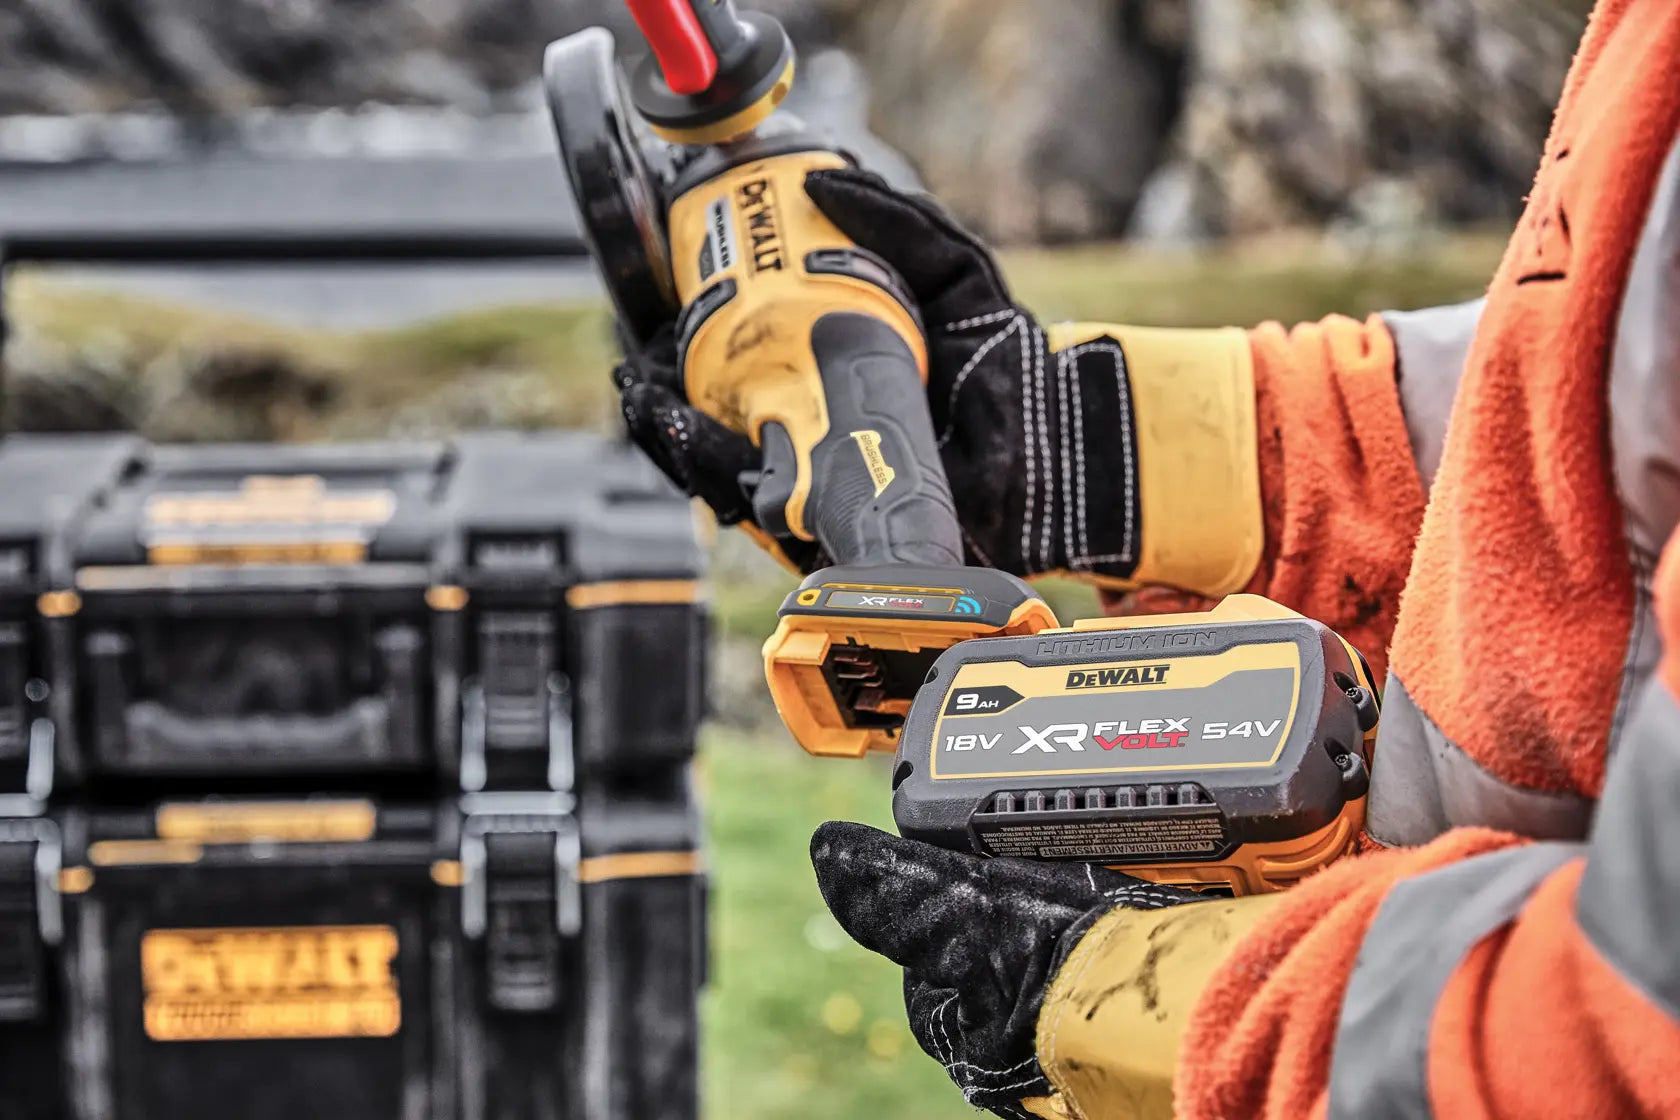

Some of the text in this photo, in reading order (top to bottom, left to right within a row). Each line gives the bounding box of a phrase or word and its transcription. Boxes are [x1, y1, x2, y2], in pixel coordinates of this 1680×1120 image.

[861, 434, 887, 484] BRUSHLESS
[858, 596, 887, 606] XR
[1036, 632, 1217, 656] LITHIUM ION
[1065, 666, 1170, 689] DEWALT
[945, 717, 1282, 755] 18V XR FLEX 54V
[1093, 731, 1189, 750] VOLT
